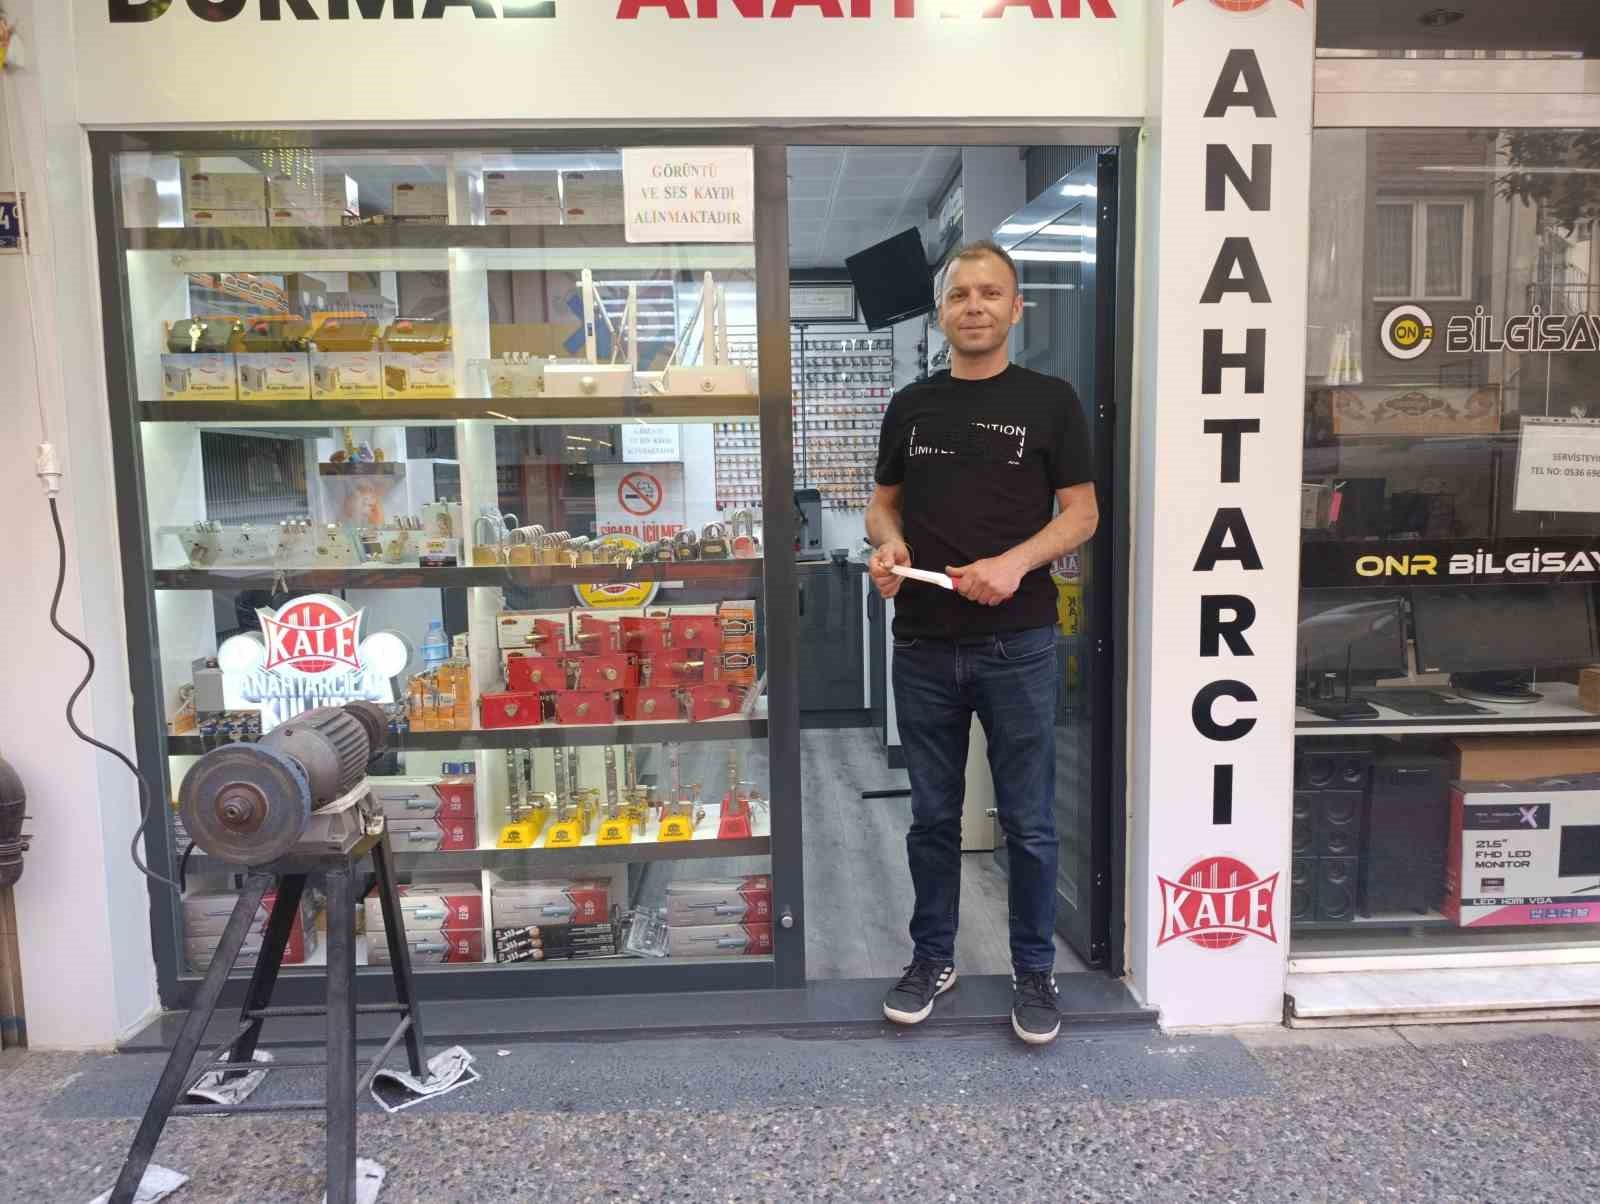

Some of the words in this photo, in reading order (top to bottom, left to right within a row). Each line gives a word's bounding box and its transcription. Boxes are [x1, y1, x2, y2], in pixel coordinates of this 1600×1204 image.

[651, 163, 718, 178] GÖRÜNTÜ
[641, 186, 658, 200] VE
[664, 185, 688, 200] SES
[694, 186, 735, 200] KAYDI
[634, 209, 742, 225] ALINMAKTADIR
[1191, 48, 1277, 826] ANAHTARCI
[909, 444, 957, 457] LIMI
[1530, 466, 1545, 475] TEL
[1355, 554, 1438, 577] ONR
[266, 620, 356, 667] KALE
[1475, 851, 1503, 859] FHD
[1508, 850, 1532, 858] LED
[1475, 860, 1531, 869] MONITOR
[1162, 878, 1273, 941] KALE
[1473, 898, 1496, 906] LED
